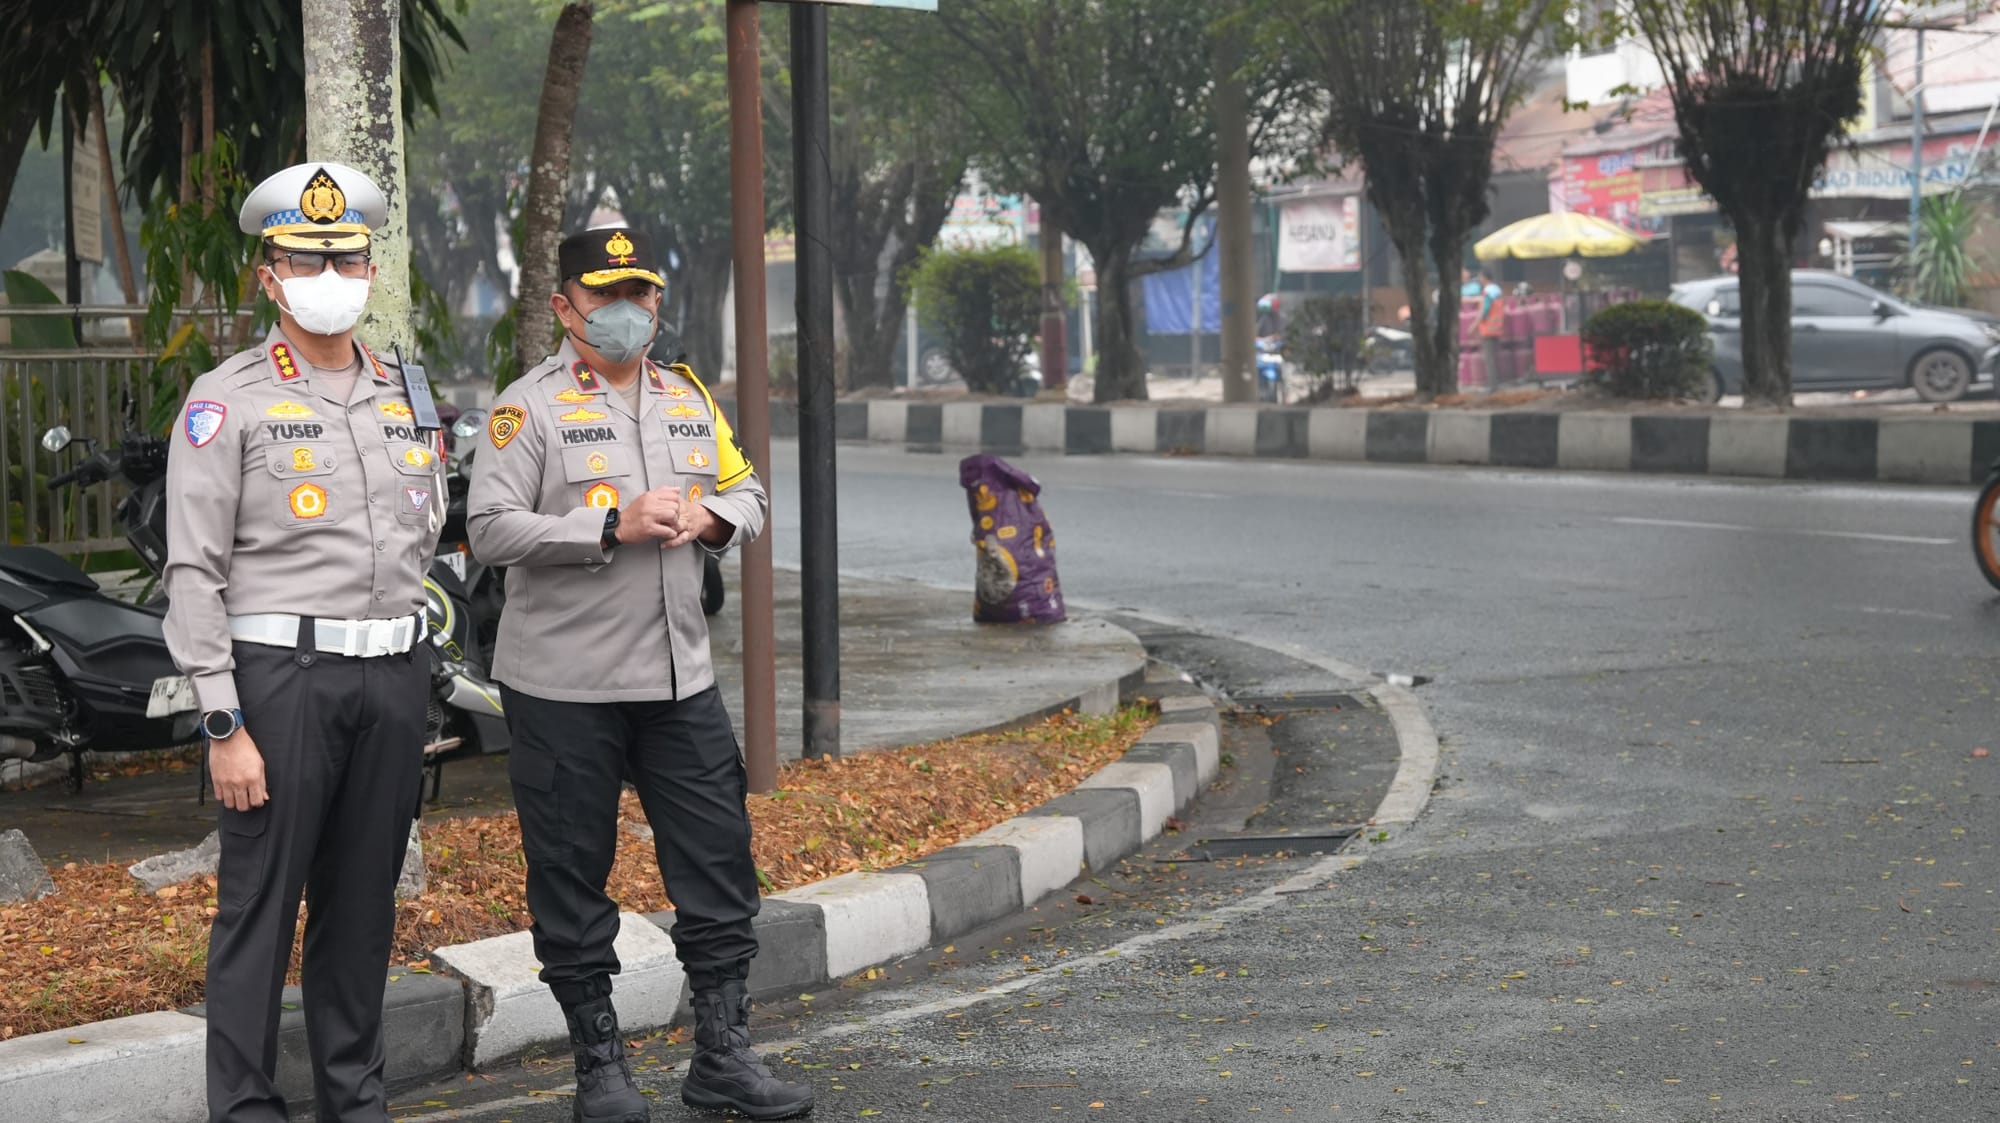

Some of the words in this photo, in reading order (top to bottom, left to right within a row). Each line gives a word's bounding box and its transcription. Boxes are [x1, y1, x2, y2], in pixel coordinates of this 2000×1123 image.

[267, 423, 323, 440] YUSEP
[383, 425, 426, 445] POLRI
[561, 427, 617, 444] HENDRA
[668, 424, 711, 437] POLRI
